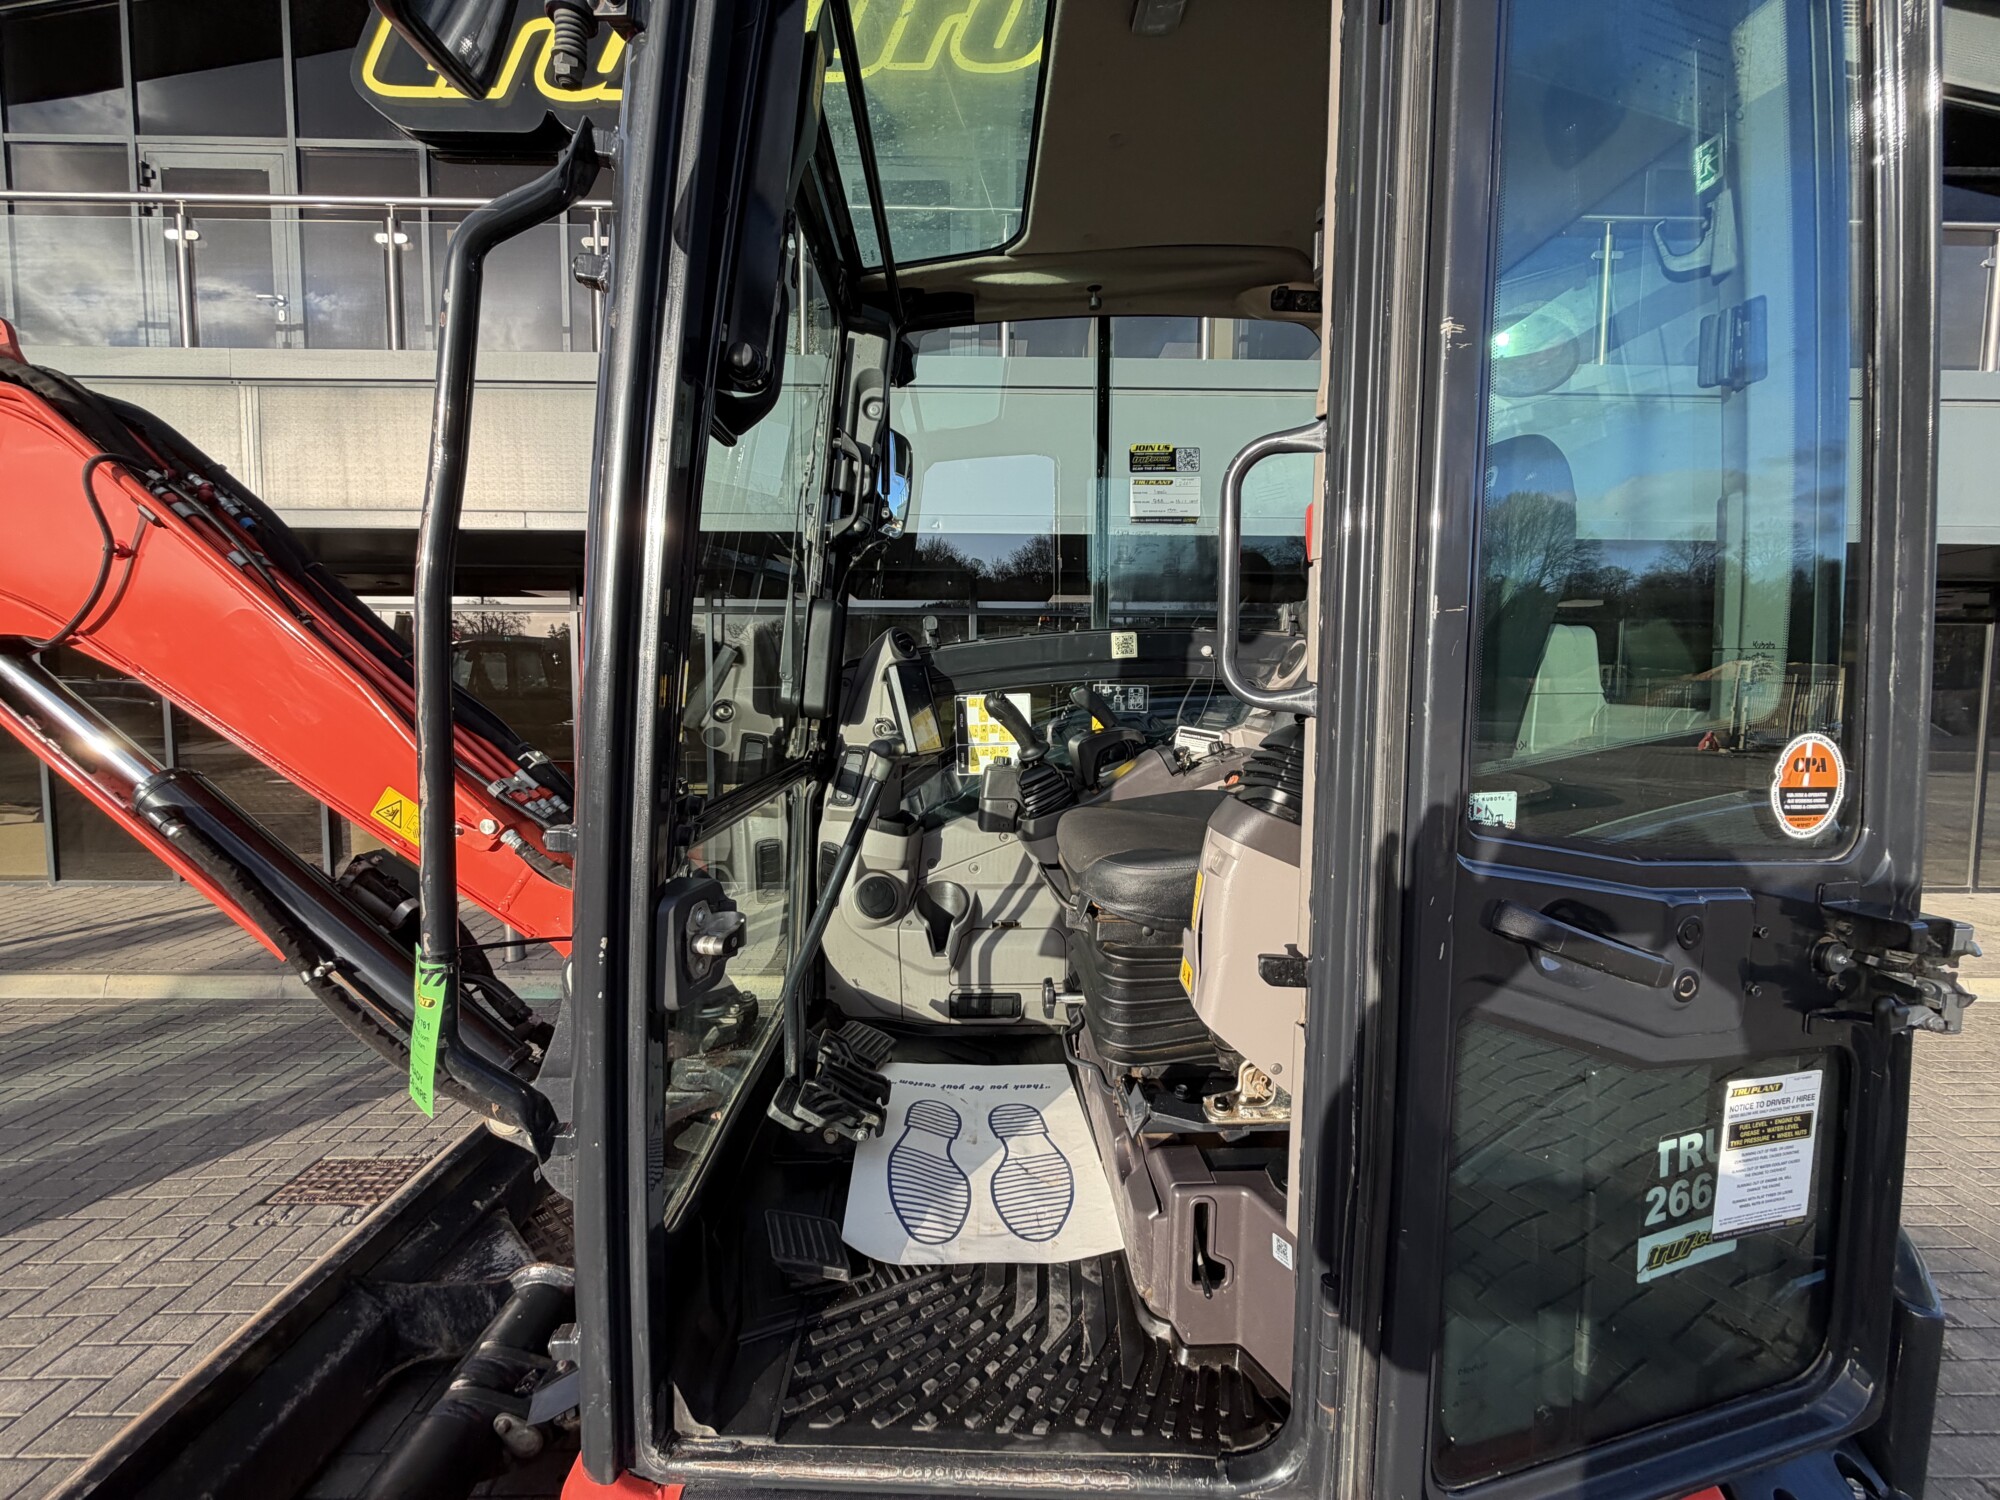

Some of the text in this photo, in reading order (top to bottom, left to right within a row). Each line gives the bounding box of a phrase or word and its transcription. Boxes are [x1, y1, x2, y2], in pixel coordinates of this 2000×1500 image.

[1793, 758, 1827, 773] CPA
[1734, 1083, 1780, 1095] TRU PLANT
[1730, 1102, 1753, 1111] NOTICE
[1766, 1097, 1790, 1106] DRIVER
[1796, 1094, 1815, 1102] HIREE
[1744, 1135, 1769, 1143] PRESSURE
